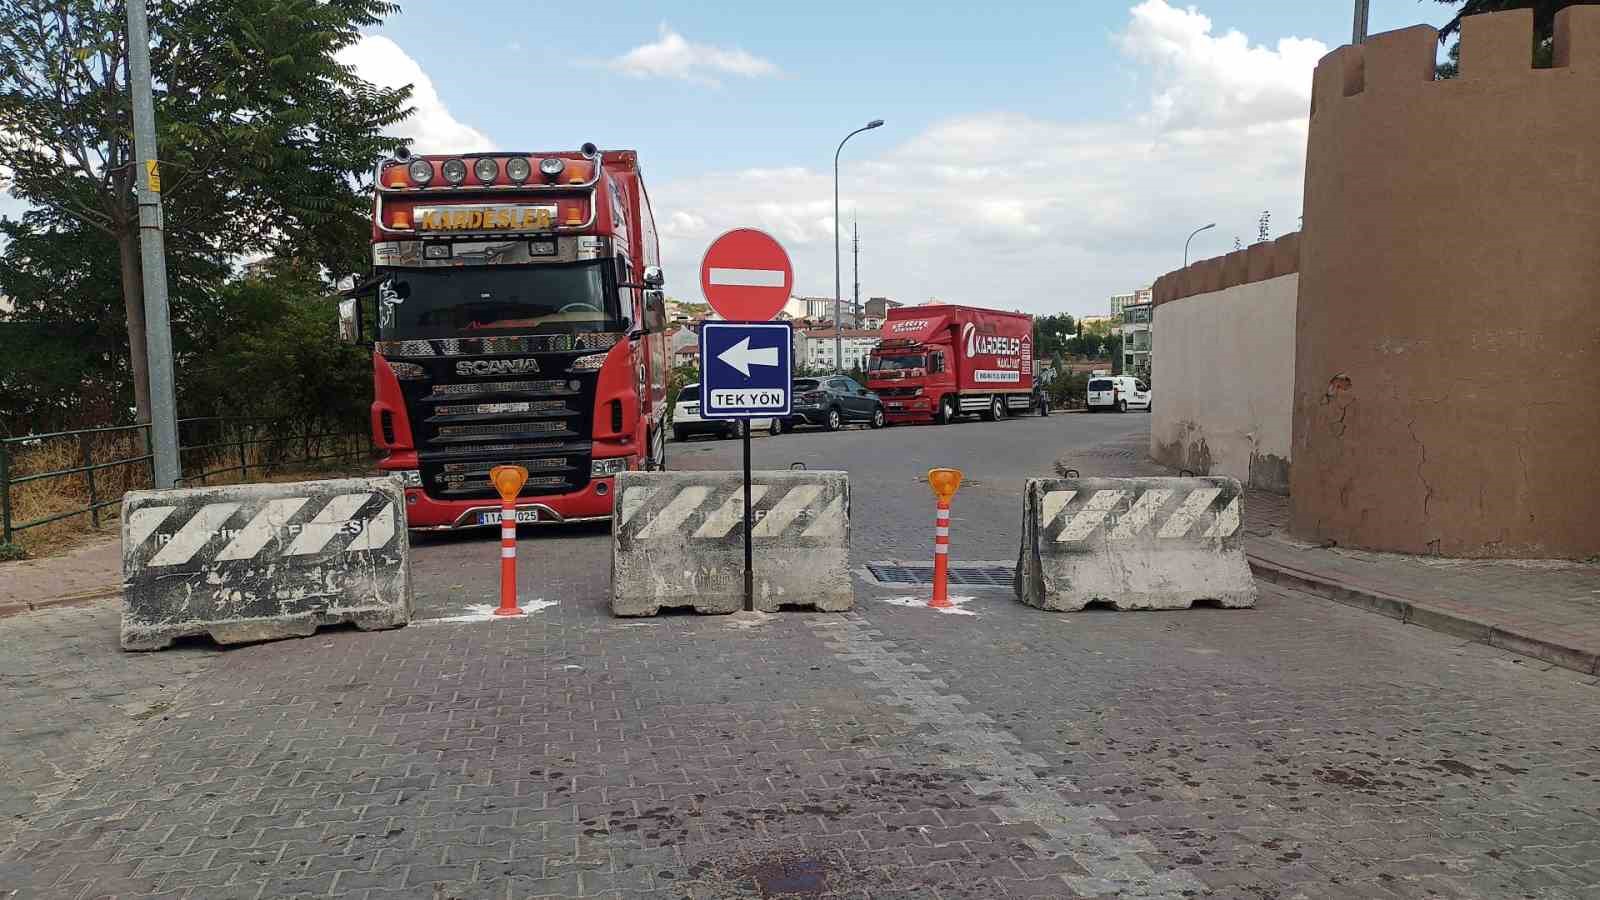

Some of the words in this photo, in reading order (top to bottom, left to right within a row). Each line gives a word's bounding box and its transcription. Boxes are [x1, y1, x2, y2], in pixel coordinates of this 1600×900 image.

[455, 358, 541, 376] SCANIA
[716, 394, 745, 406] TEK
[750, 391, 780, 405] YÖN
